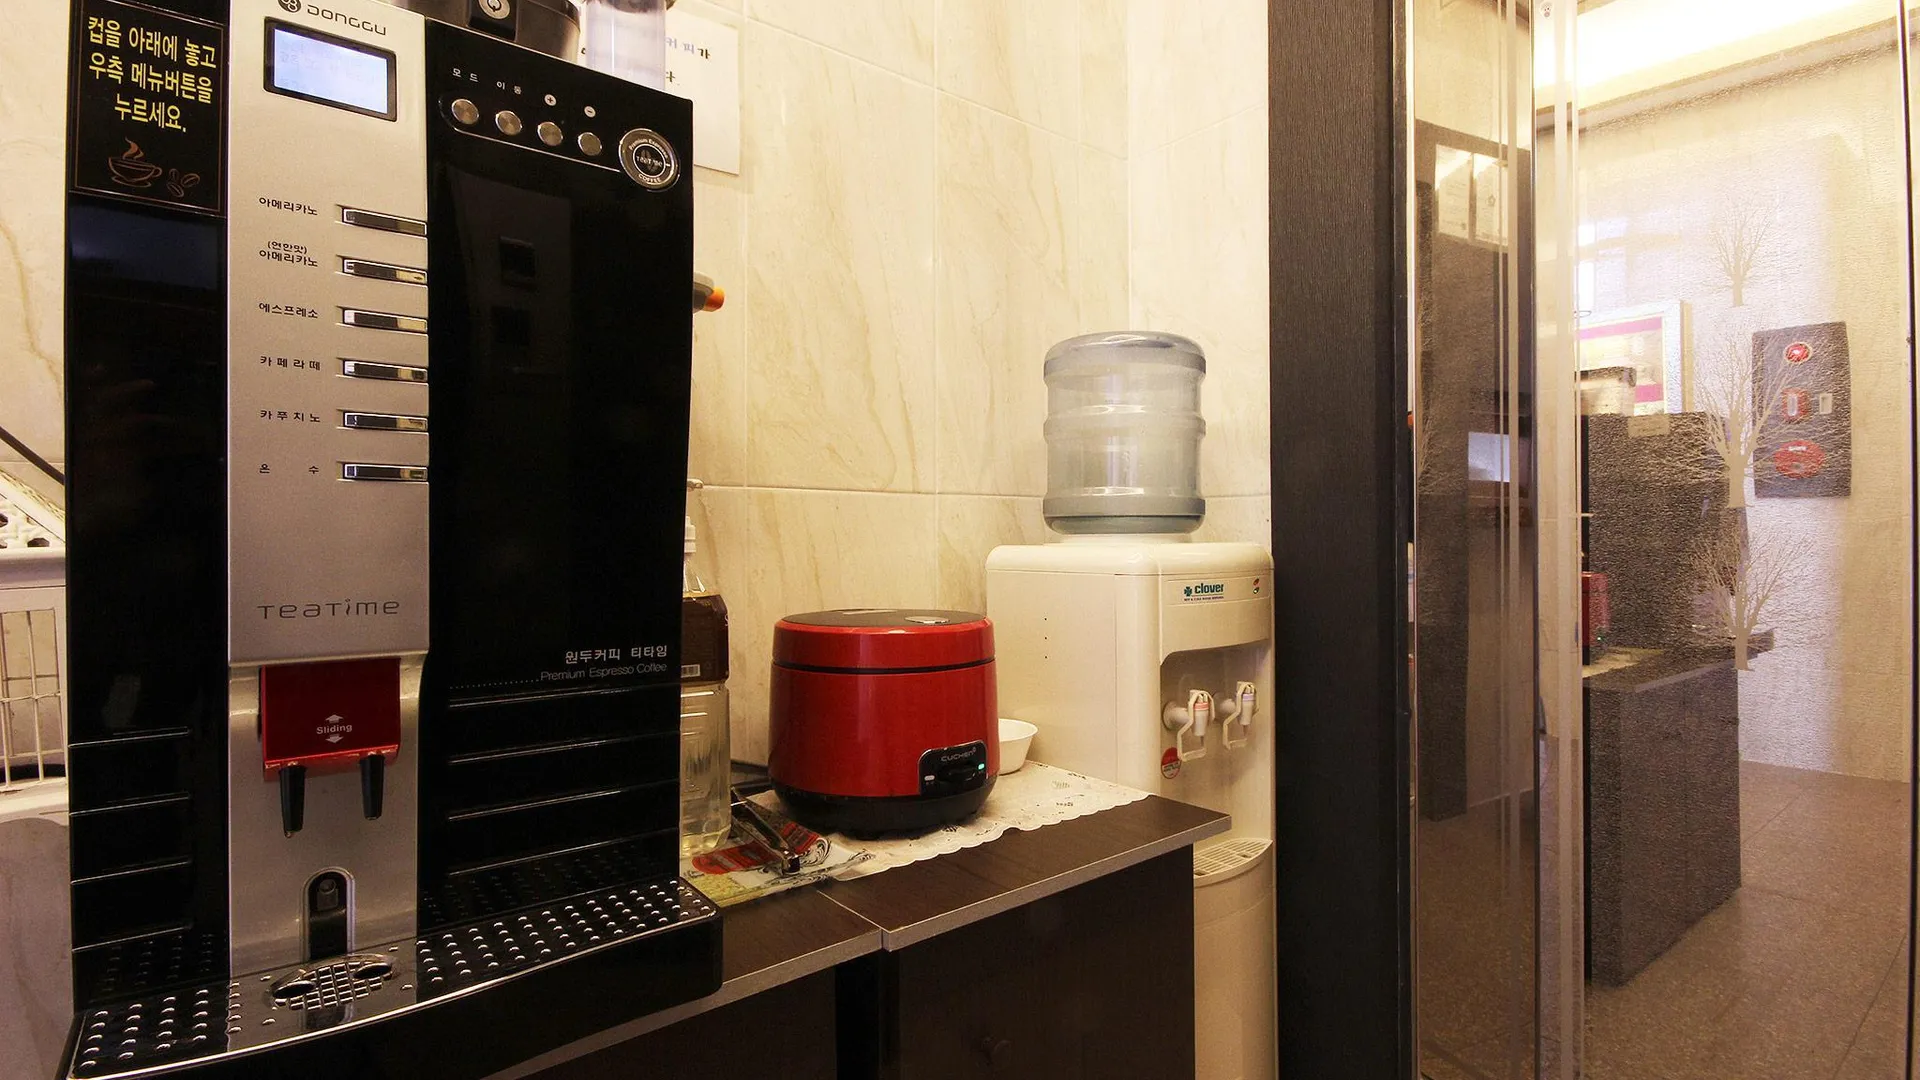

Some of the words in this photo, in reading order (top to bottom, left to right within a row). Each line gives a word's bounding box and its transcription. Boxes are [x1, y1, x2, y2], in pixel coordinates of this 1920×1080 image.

[88, 16, 121, 48] 컵을
[129, 27, 178, 62] 아래에
[185, 38, 216, 68] 놓고
[89, 52, 124, 84] 우측
[131, 63, 213, 104] 메뉴버튼을
[114, 93, 187, 132] 누르세요.
[258, 196, 318, 216] 아메리카노
[258, 249, 318, 267] 아메리카노
[258, 302, 318, 319] 에스프레소
[1194, 583, 1225, 594] clover
[564, 648, 622, 665] 원두커피
[630, 645, 668, 659] 티타임
[540, 669, 586, 682] Premium
[588, 665, 635, 680] Espresso
[636, 661, 668, 674] Coffee
[316, 723, 353, 735] Sliding
